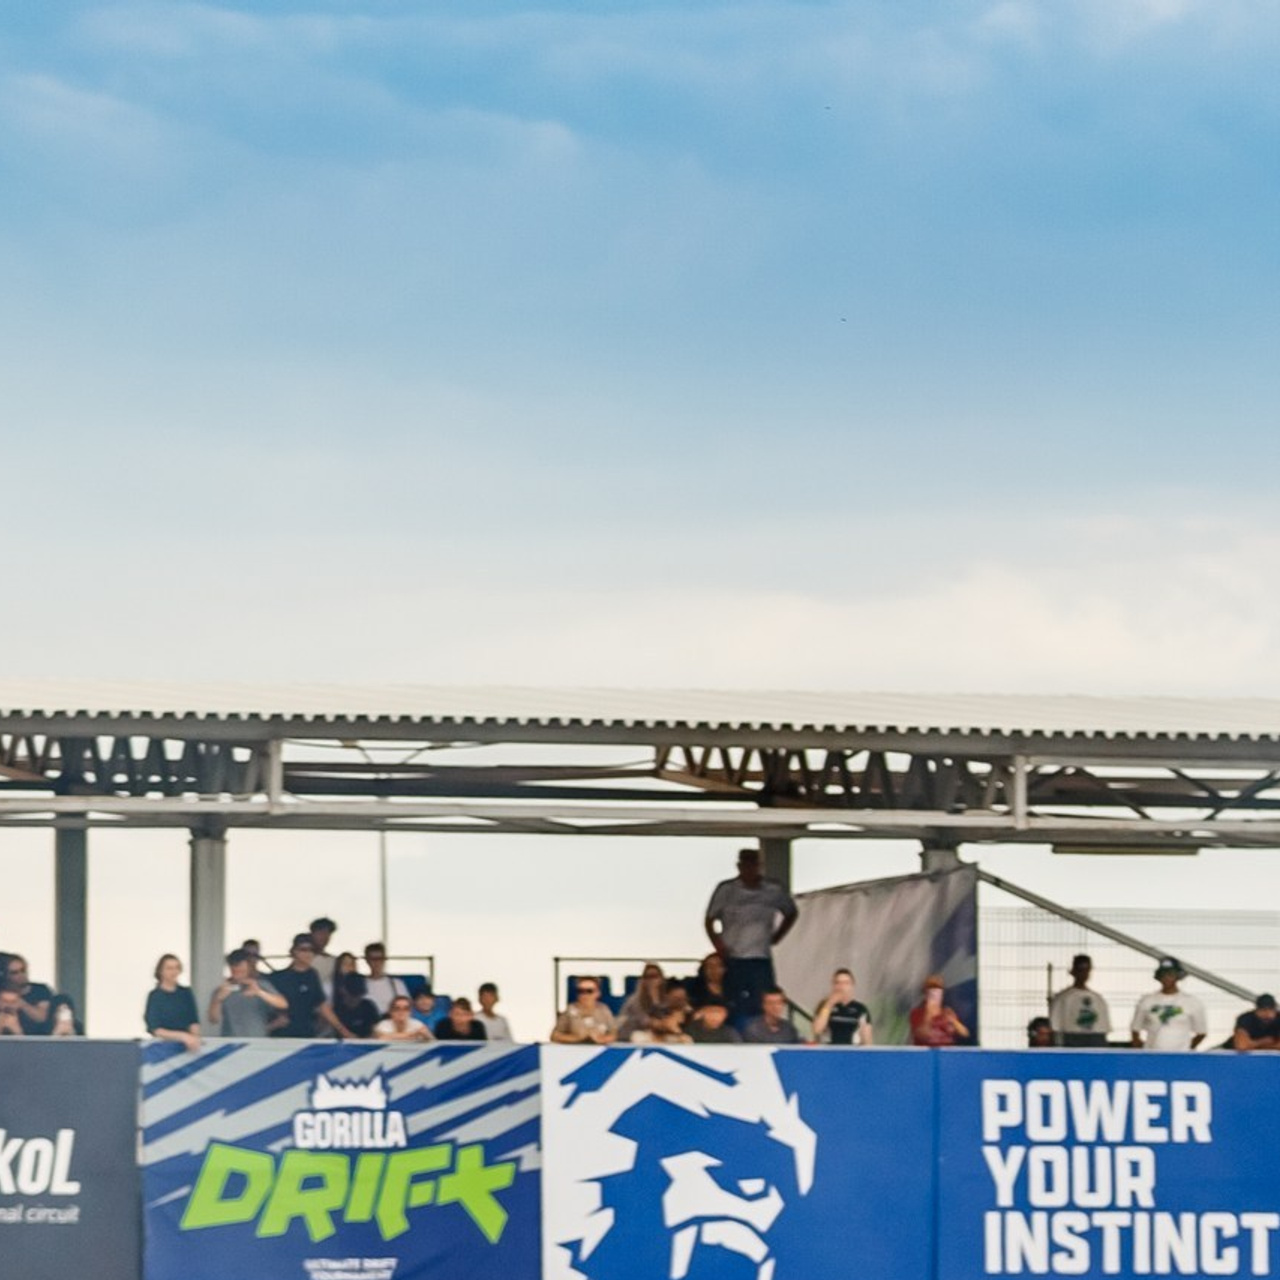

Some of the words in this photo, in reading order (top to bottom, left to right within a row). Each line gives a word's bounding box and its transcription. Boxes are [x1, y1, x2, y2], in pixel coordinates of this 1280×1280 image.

[293, 1111, 408, 1148] GORILLA
[981, 1079, 1212, 1143] POWER
[179, 1143, 516, 1244] DRIFT
[981, 1145, 1156, 1208] YOUR
[984, 1211, 1280, 1276] INSTINCT
